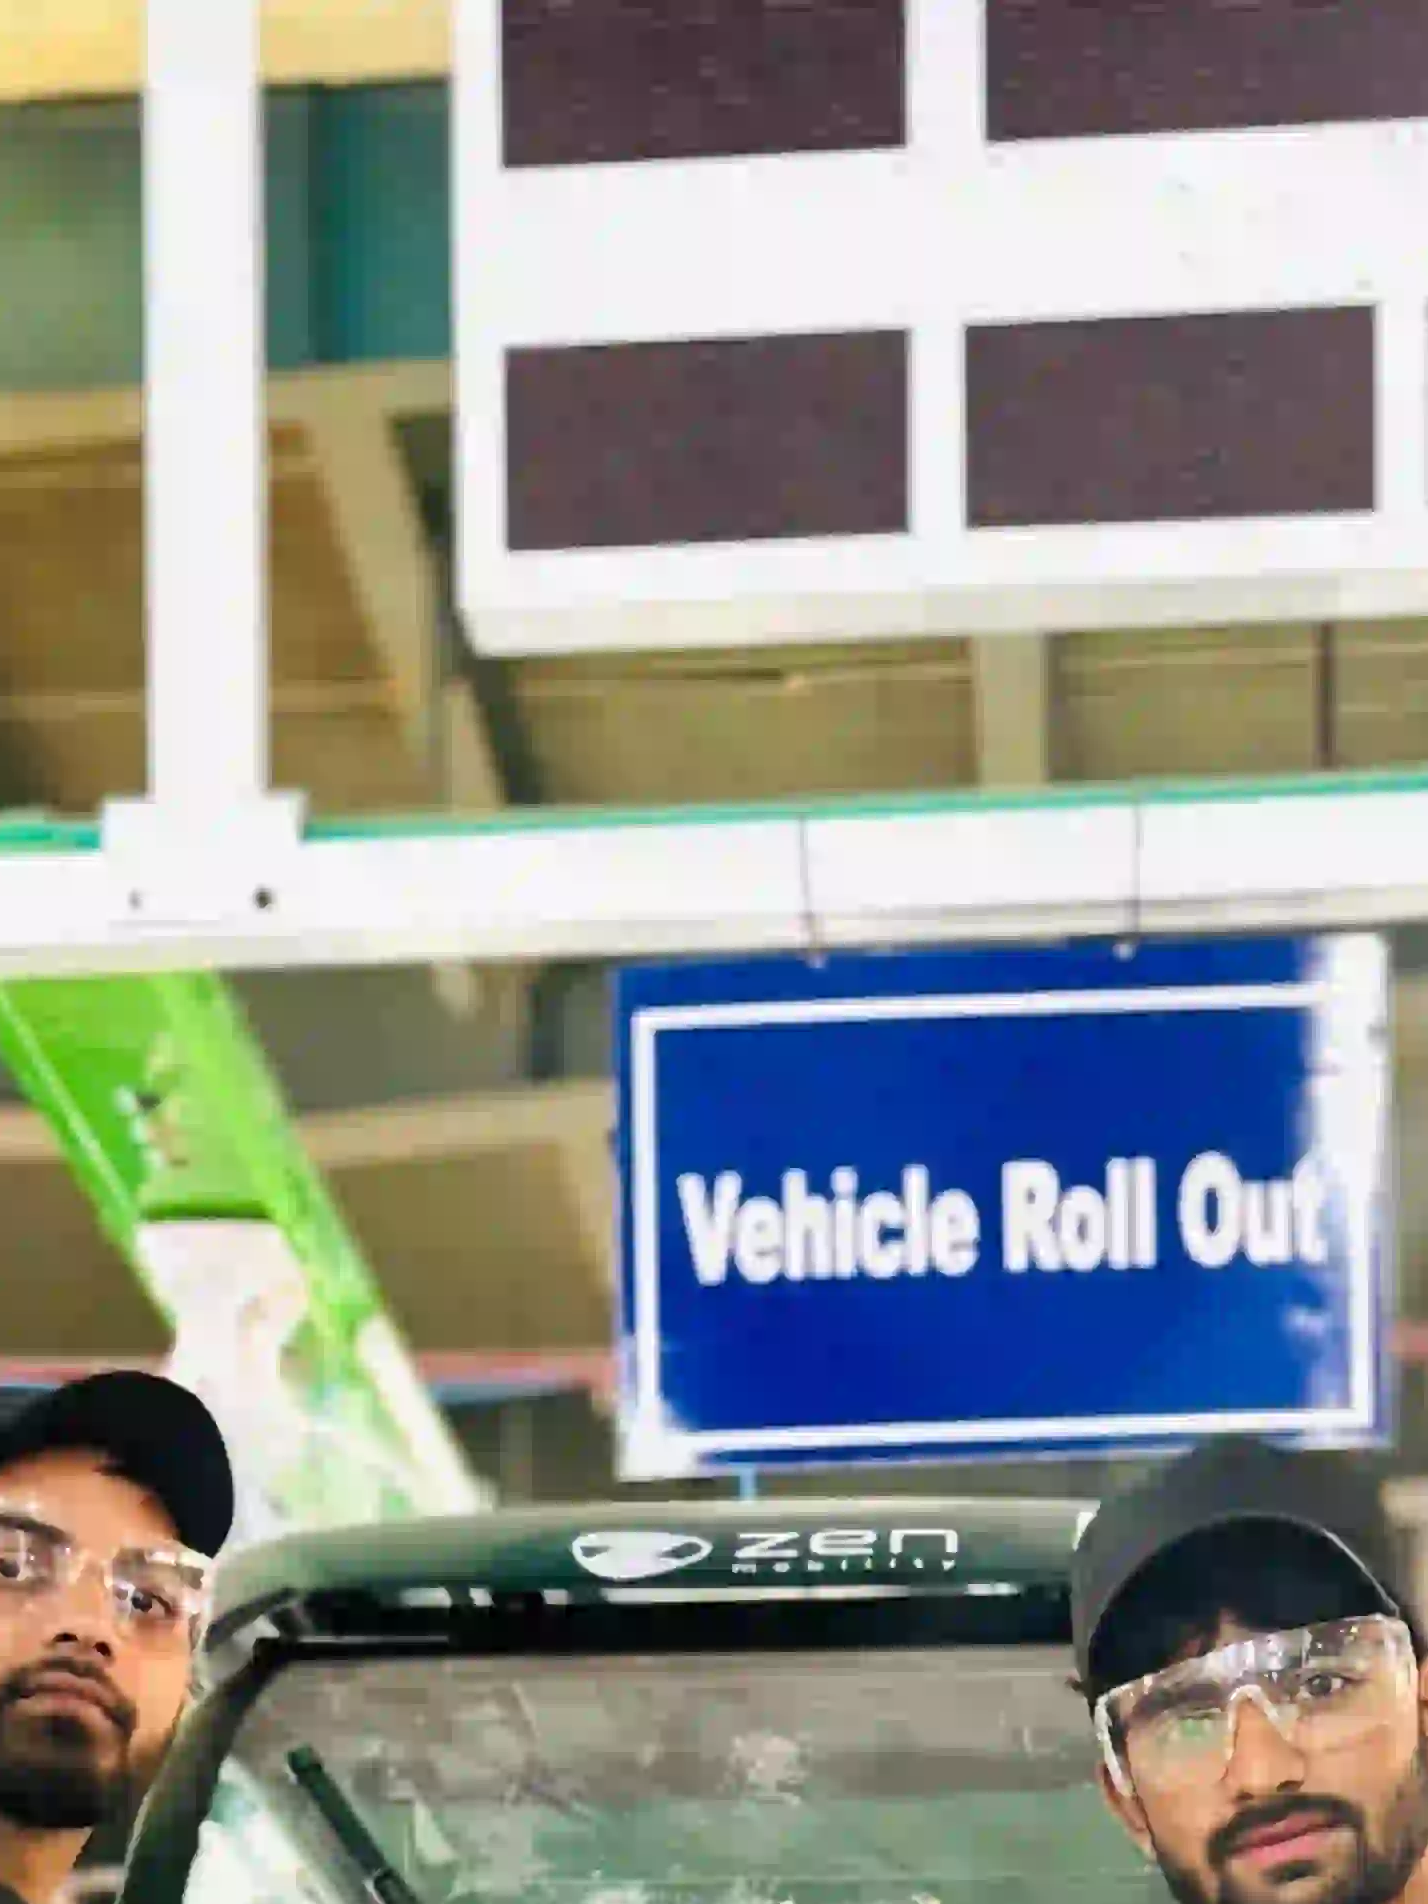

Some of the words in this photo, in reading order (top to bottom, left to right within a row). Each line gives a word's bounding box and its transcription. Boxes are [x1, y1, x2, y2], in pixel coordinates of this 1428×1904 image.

[676, 1163, 980, 1286] Vehicle
[1001, 1156, 1158, 1273] Roll
[1178, 1150, 1330, 1268] Out
[733, 1528, 959, 1559] zen
